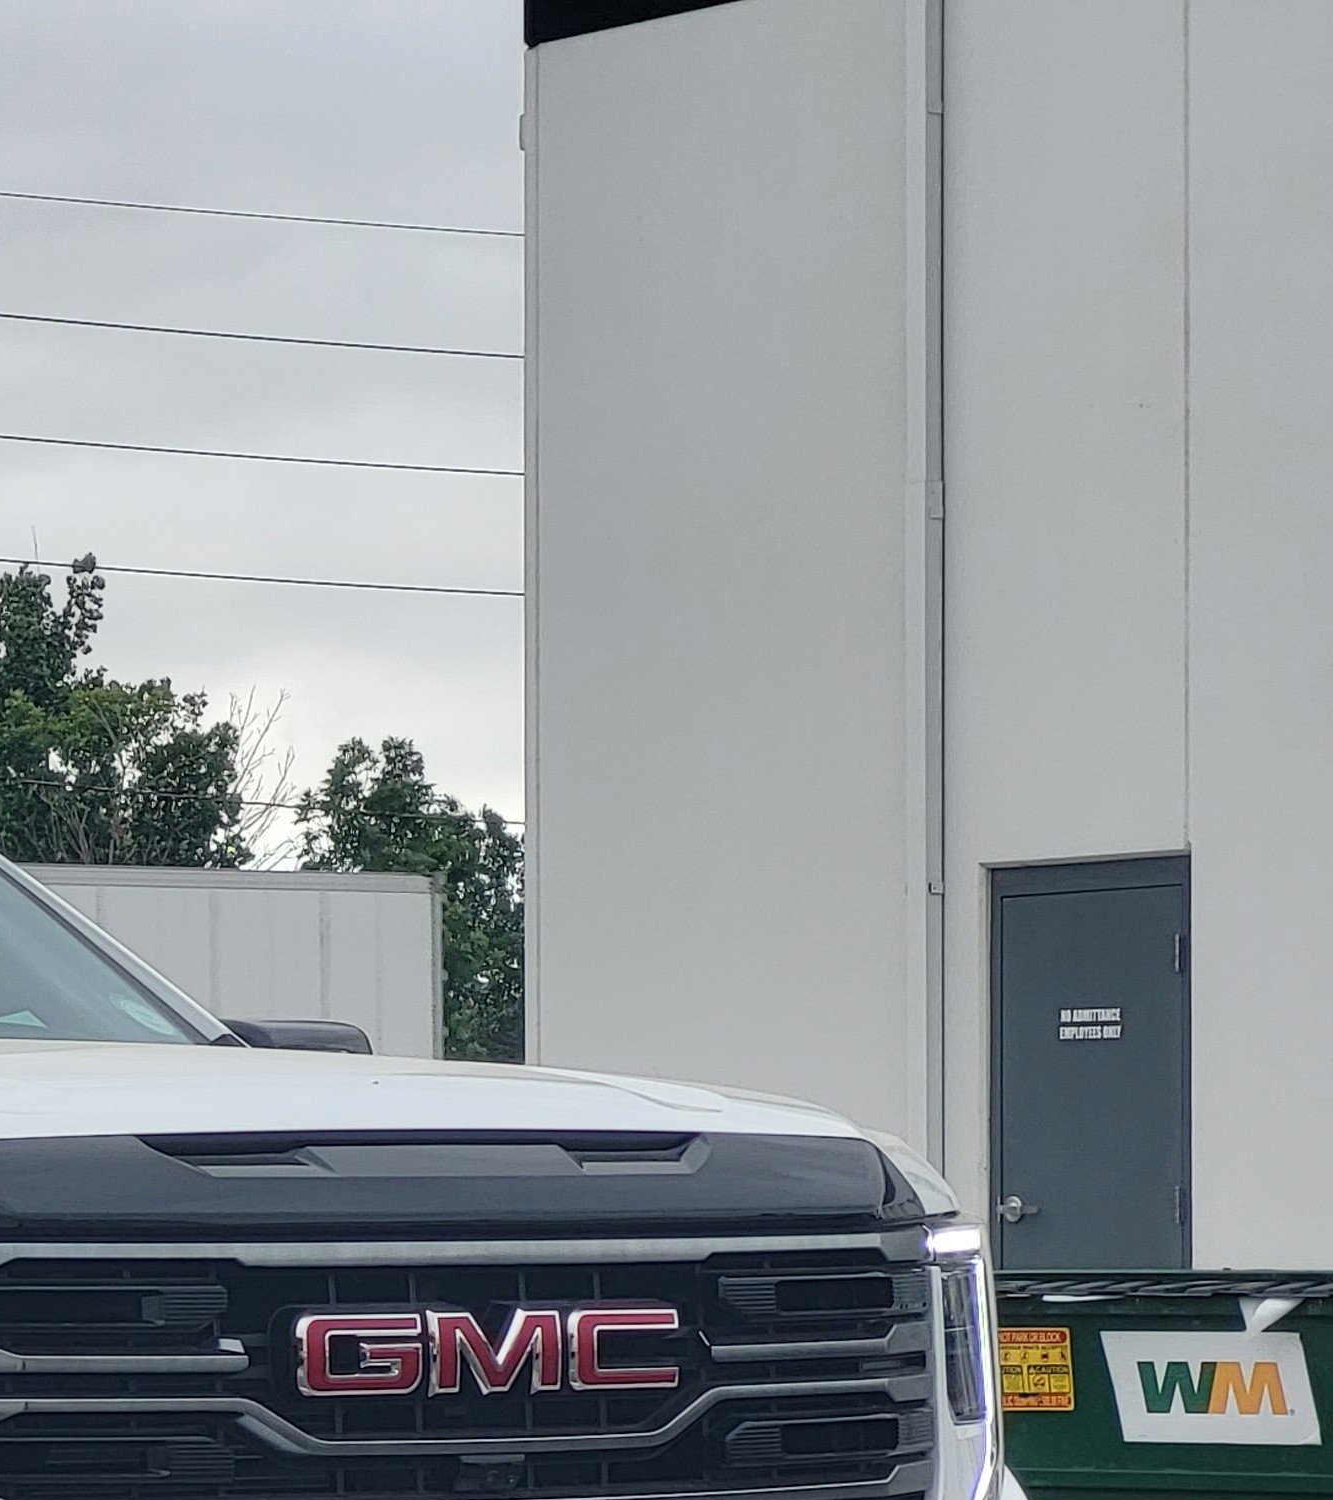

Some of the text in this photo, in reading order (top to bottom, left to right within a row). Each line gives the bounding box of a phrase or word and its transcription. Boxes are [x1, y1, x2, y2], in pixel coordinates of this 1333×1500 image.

[1059, 1026, 1102, 1040] EMPLOYEES
[295, 1307, 679, 1397] GMC
[1136, 1361, 1288, 1416] WM
